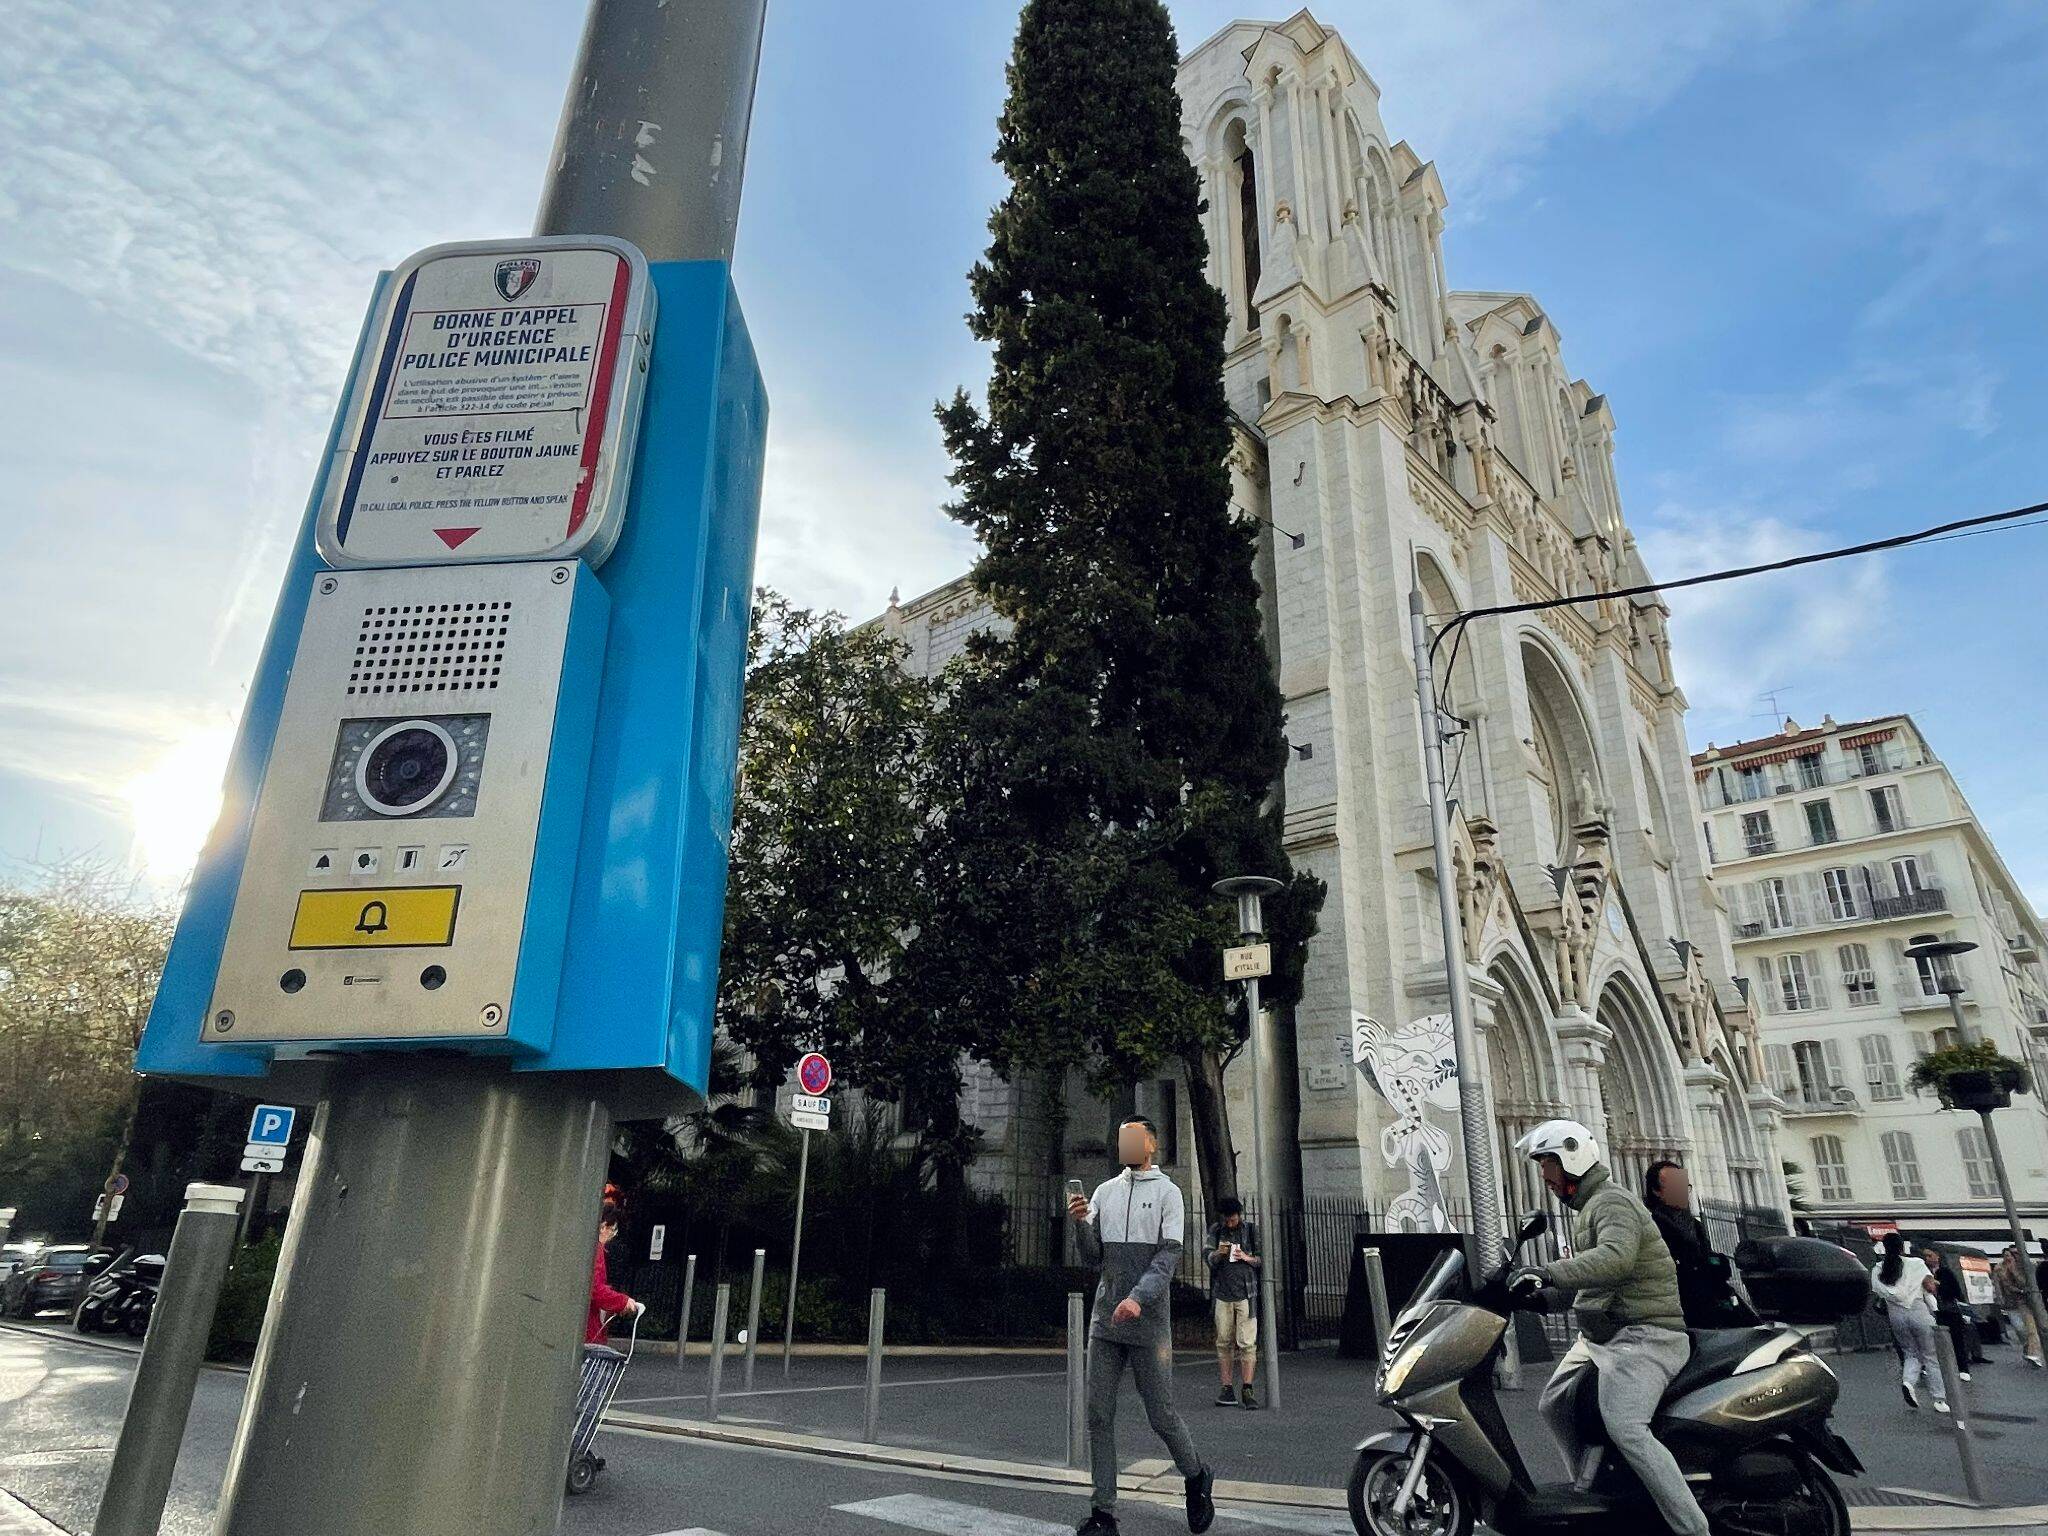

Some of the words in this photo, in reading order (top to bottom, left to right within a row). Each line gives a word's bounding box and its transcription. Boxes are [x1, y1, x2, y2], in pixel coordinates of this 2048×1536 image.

[432, 312, 496, 330] BORNE
[501, 308, 578, 327] D'APPEL
[447, 328, 556, 348] D'URGENCE
[403, 351, 471, 370] POLICE
[474, 345, 591, 367] MUNICIPALE
[455, 377, 488, 385] abusive
[398, 388, 418, 396] dans
[498, 392, 514, 400] des
[505, 401, 527, 409] code
[424, 433, 457, 446] VOUS
[495, 427, 535, 443] FILMÉ
[370, 451, 429, 465] APPUYEZ
[432, 449, 458, 462] SUR
[462, 448, 477, 461] LE
[481, 446, 532, 460] BOUTON
[535, 443, 580, 458] JAUNE
[436, 466, 451, 479] ET
[454, 464, 505, 478] PARLEZ
[360, 503, 368, 512] TO
[369, 503, 385, 511] CALL
[387, 502, 407, 511] LOCAL
[436, 500, 458, 508] PRESS
[459, 499, 471, 508] THE
[473, 498, 500, 507] YELLOW
[502, 496, 528, 506] BUTTON
[530, 496, 544, 504] AND
[546, 494, 569, 504] SPEAK
[797, 1098, 817, 1108] SAUF
[261, 1113, 282, 1137] P
